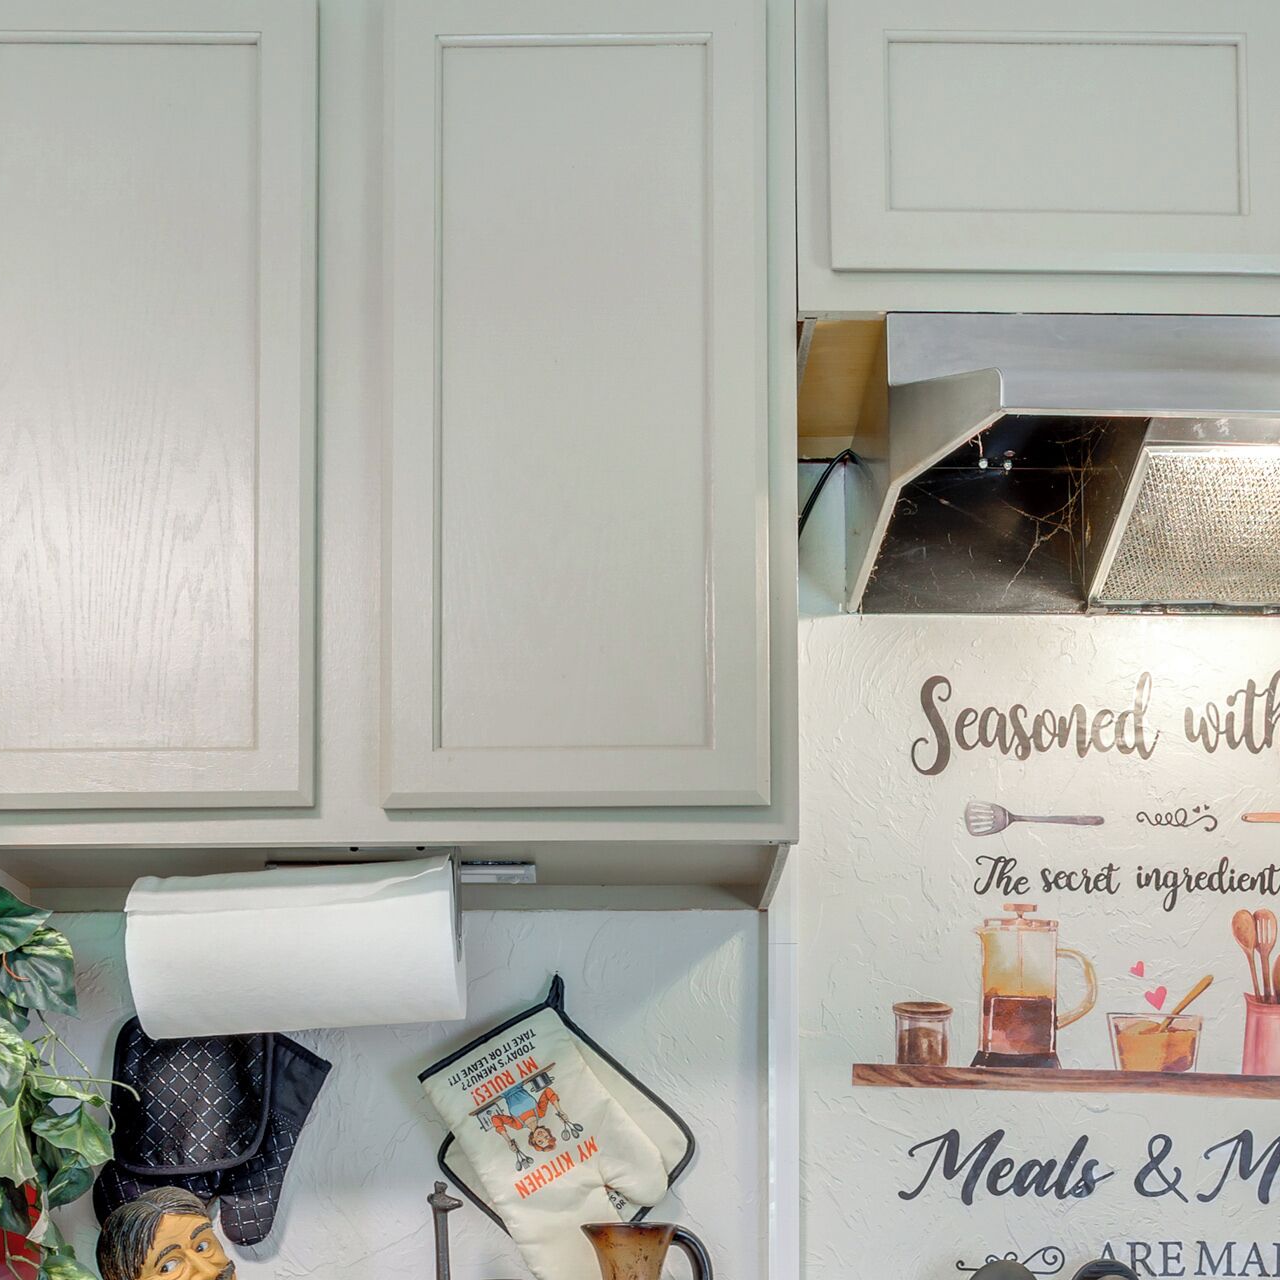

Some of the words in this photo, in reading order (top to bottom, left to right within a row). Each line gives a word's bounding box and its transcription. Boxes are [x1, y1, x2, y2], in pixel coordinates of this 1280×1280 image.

[911, 671, 1160, 776] Seasoned
[974, 855, 1031, 896] The
[1041, 862, 1121, 895] secret
[502, 1042, 512, 1053] IT
[512, 1029, 536, 1048] TAKE
[461, 1056, 489, 1078] LEAVE
[488, 1048, 502, 1060] OR
[497, 1041, 536, 1068] TODAY'S
[516, 1056, 539, 1079] MY
[448, 1074, 462, 1087] IT!
[462, 1063, 498, 1091] MENU??
[471, 1070, 516, 1106] RULES!
[577, 1136, 598, 1163] MY
[514, 1151, 575, 1199] KITCHEN
[898, 1129, 1115, 1202] Meals
[1134, 1133, 1189, 1201] &
[1100, 1240, 1187, 1278] ARE
